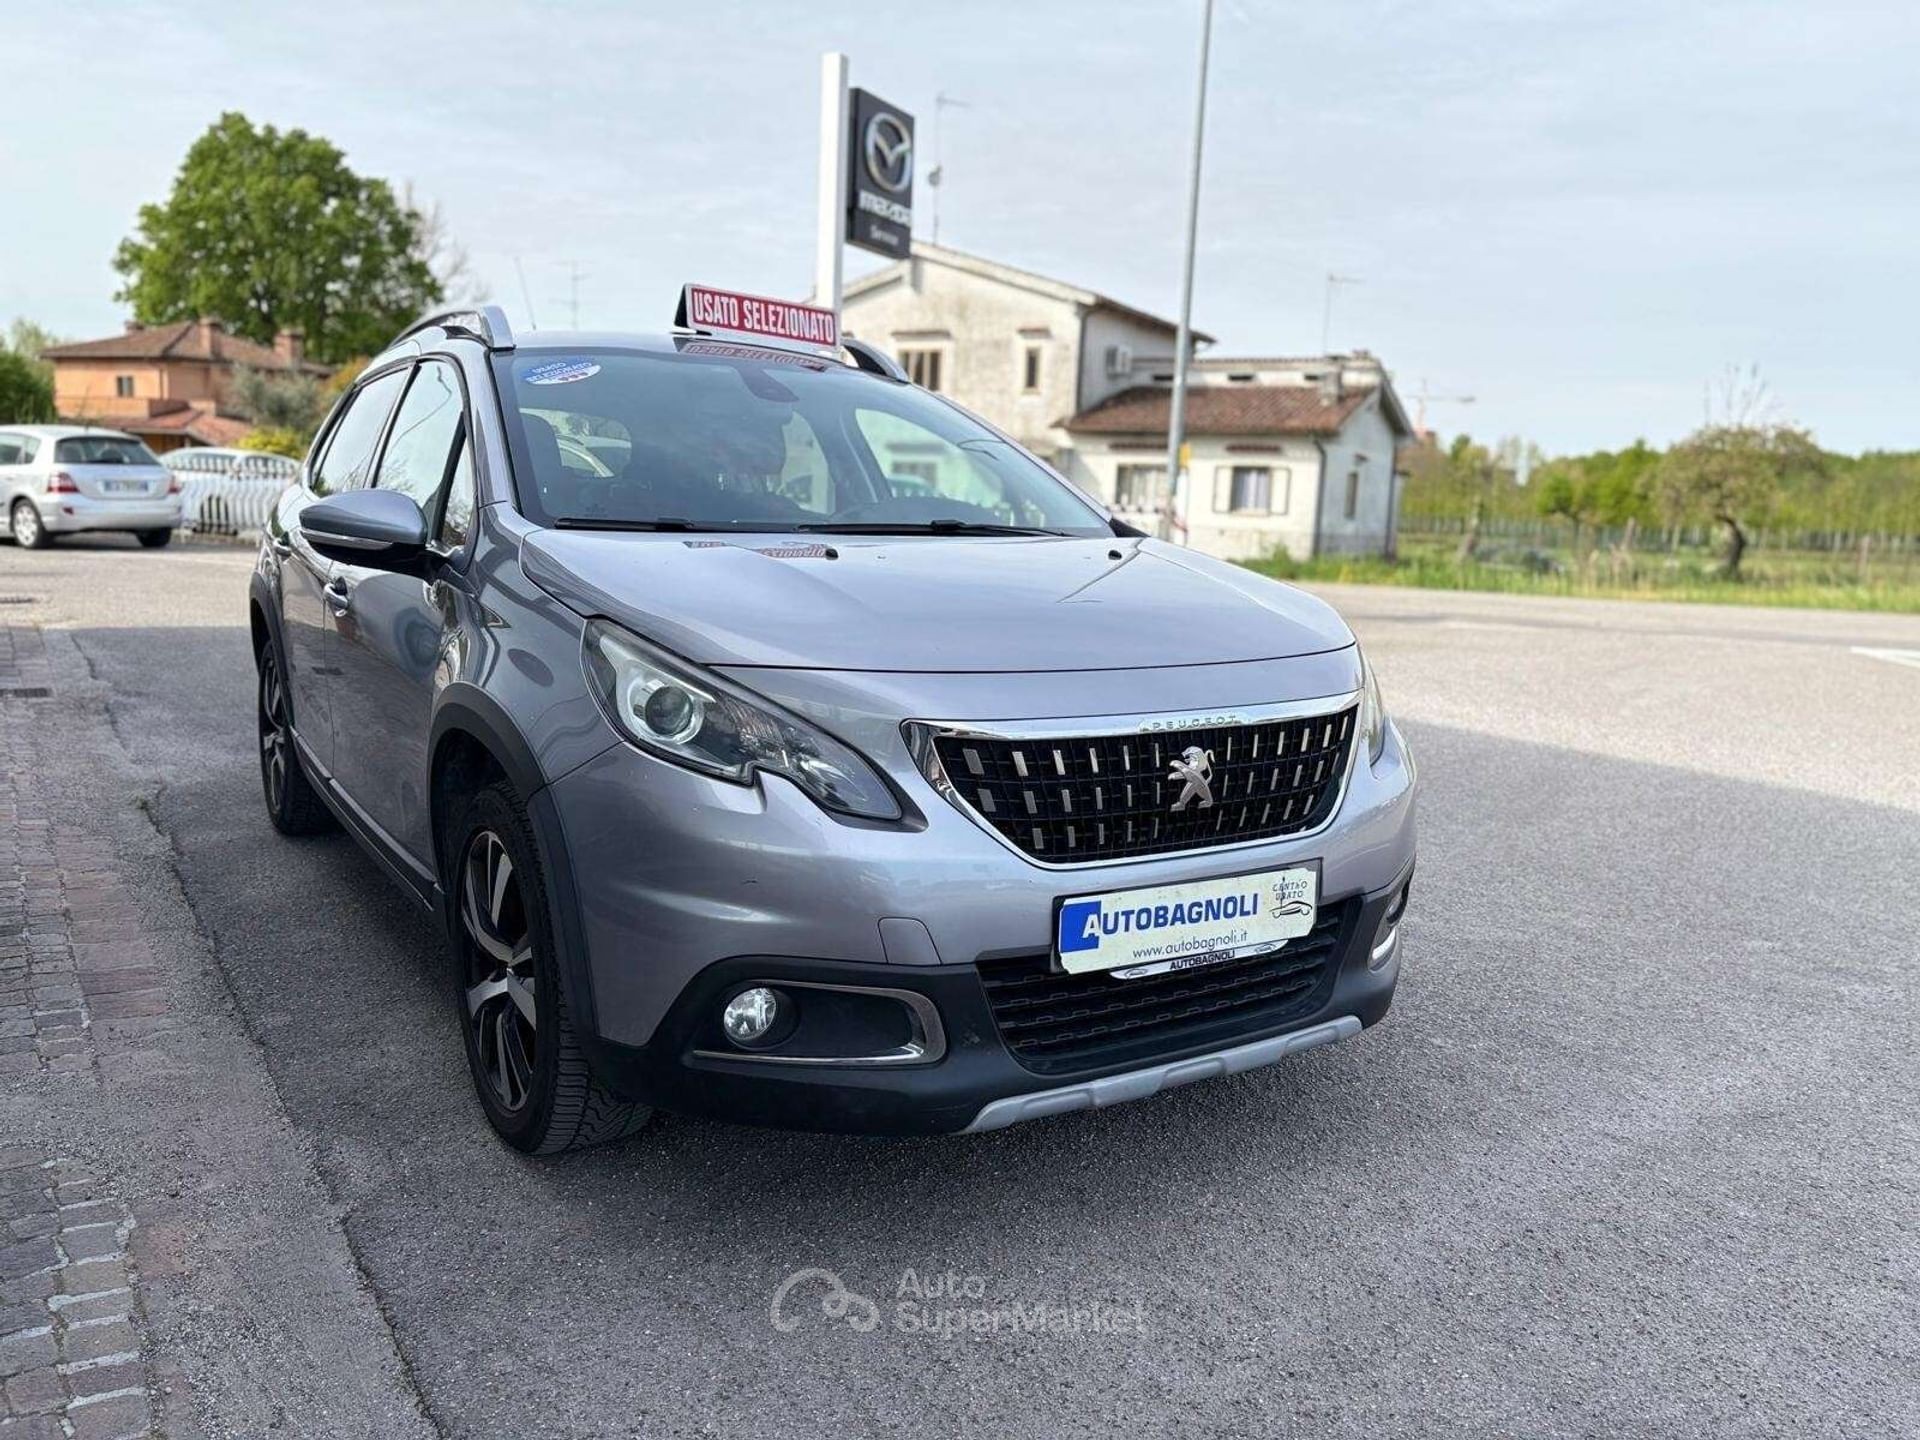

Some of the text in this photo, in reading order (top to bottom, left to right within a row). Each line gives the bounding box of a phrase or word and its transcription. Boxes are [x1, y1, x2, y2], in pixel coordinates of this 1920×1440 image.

[693, 291, 834, 343] USATO SELEZIONATO
[1152, 715, 1236, 730] PEUGEOT
[1082, 893, 1258, 940] AUTOBAGNOLI
[1132, 930, 1248, 959] www.autobagnoli.it
[1169, 950, 1236, 970] AUTOBAGNOLI
